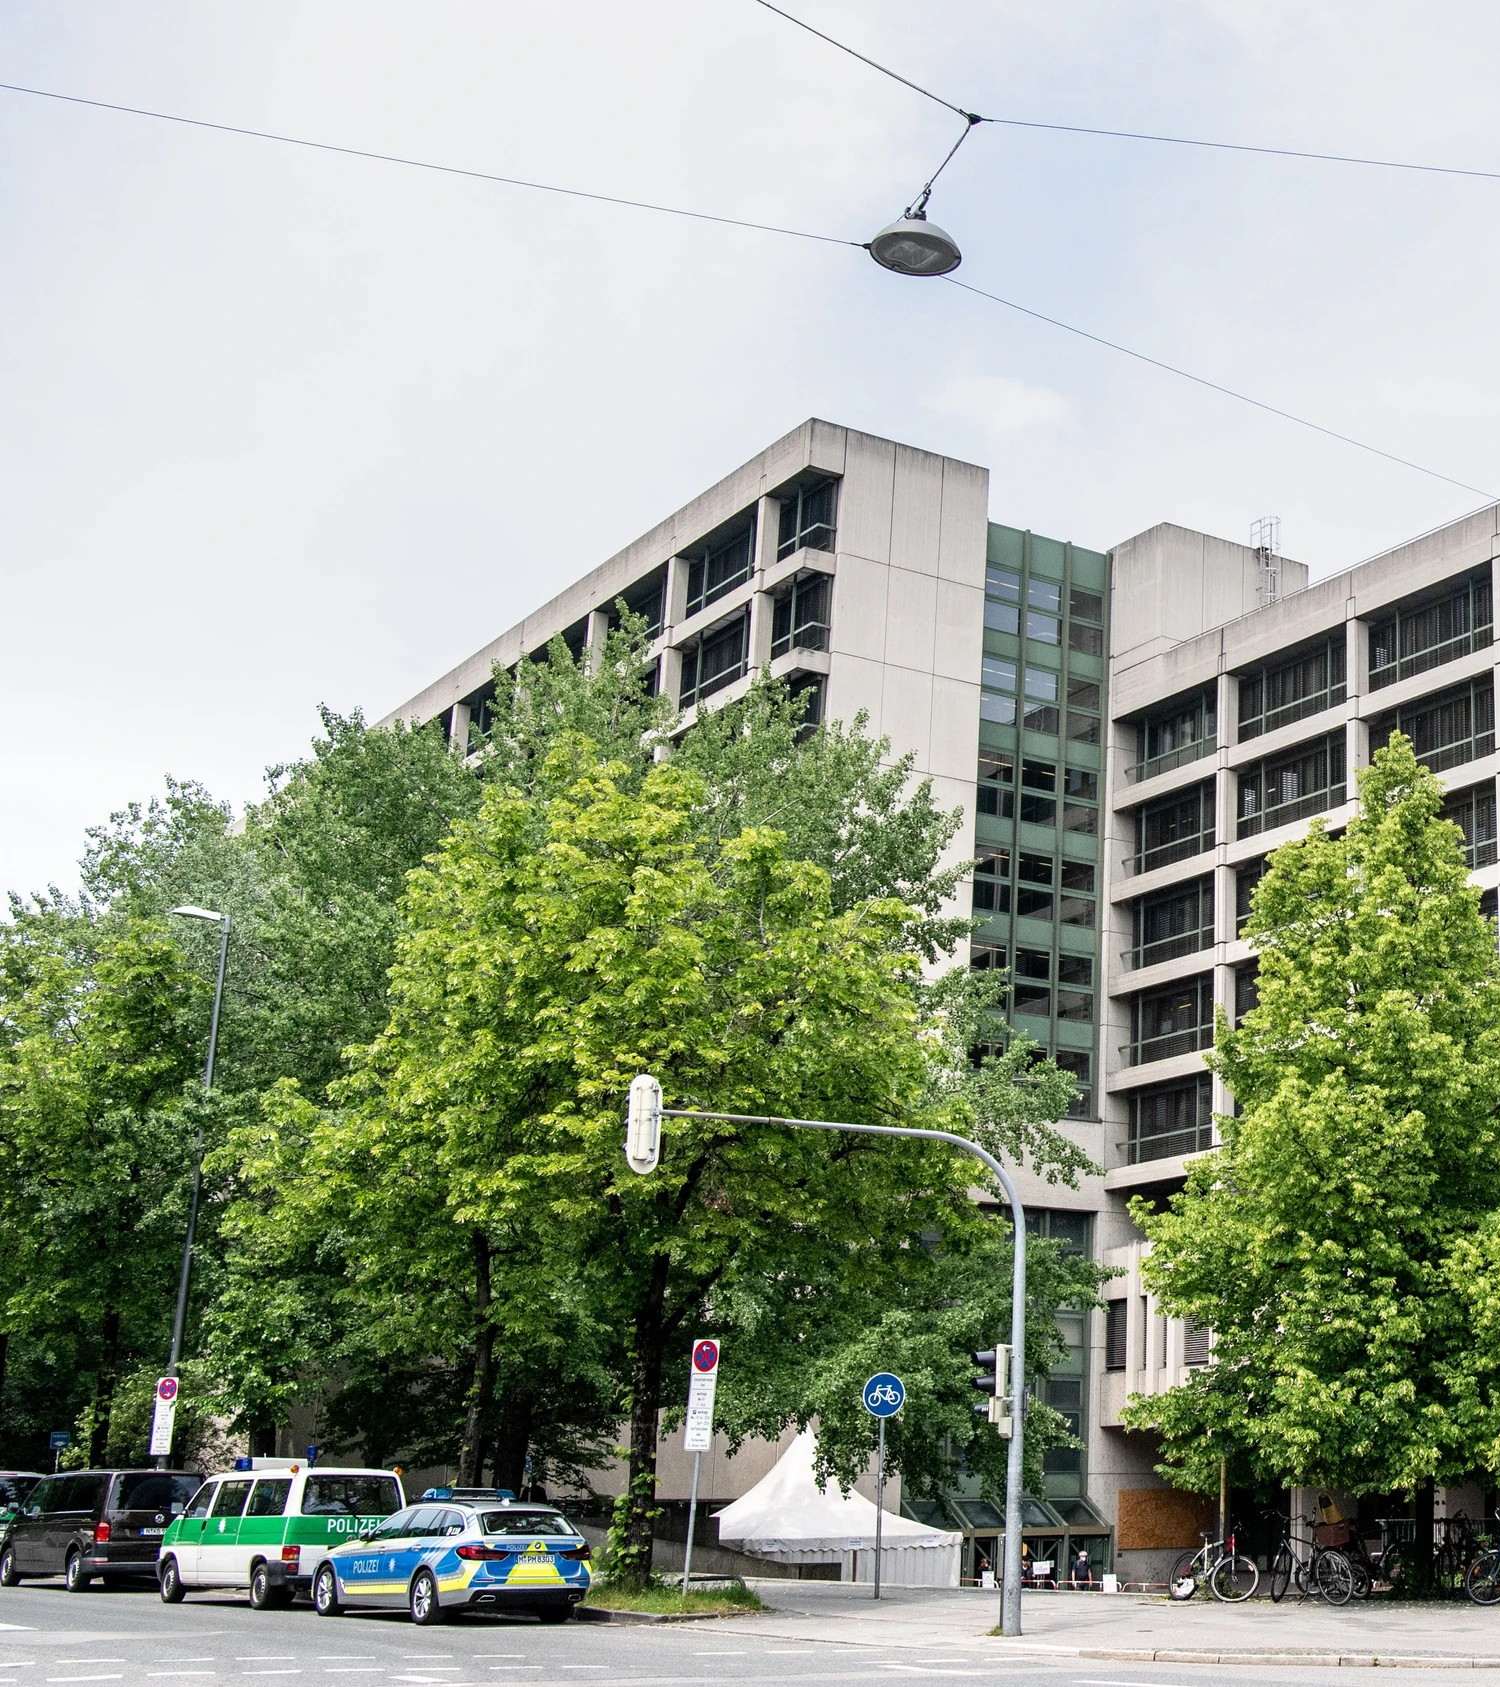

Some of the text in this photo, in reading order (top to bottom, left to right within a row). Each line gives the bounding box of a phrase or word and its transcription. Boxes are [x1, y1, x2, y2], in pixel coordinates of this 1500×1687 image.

[327, 1518, 381, 1533] POLIZEI
[537, 1555, 554, 1563] 8303
[352, 1559, 380, 1575] POLIZEI
